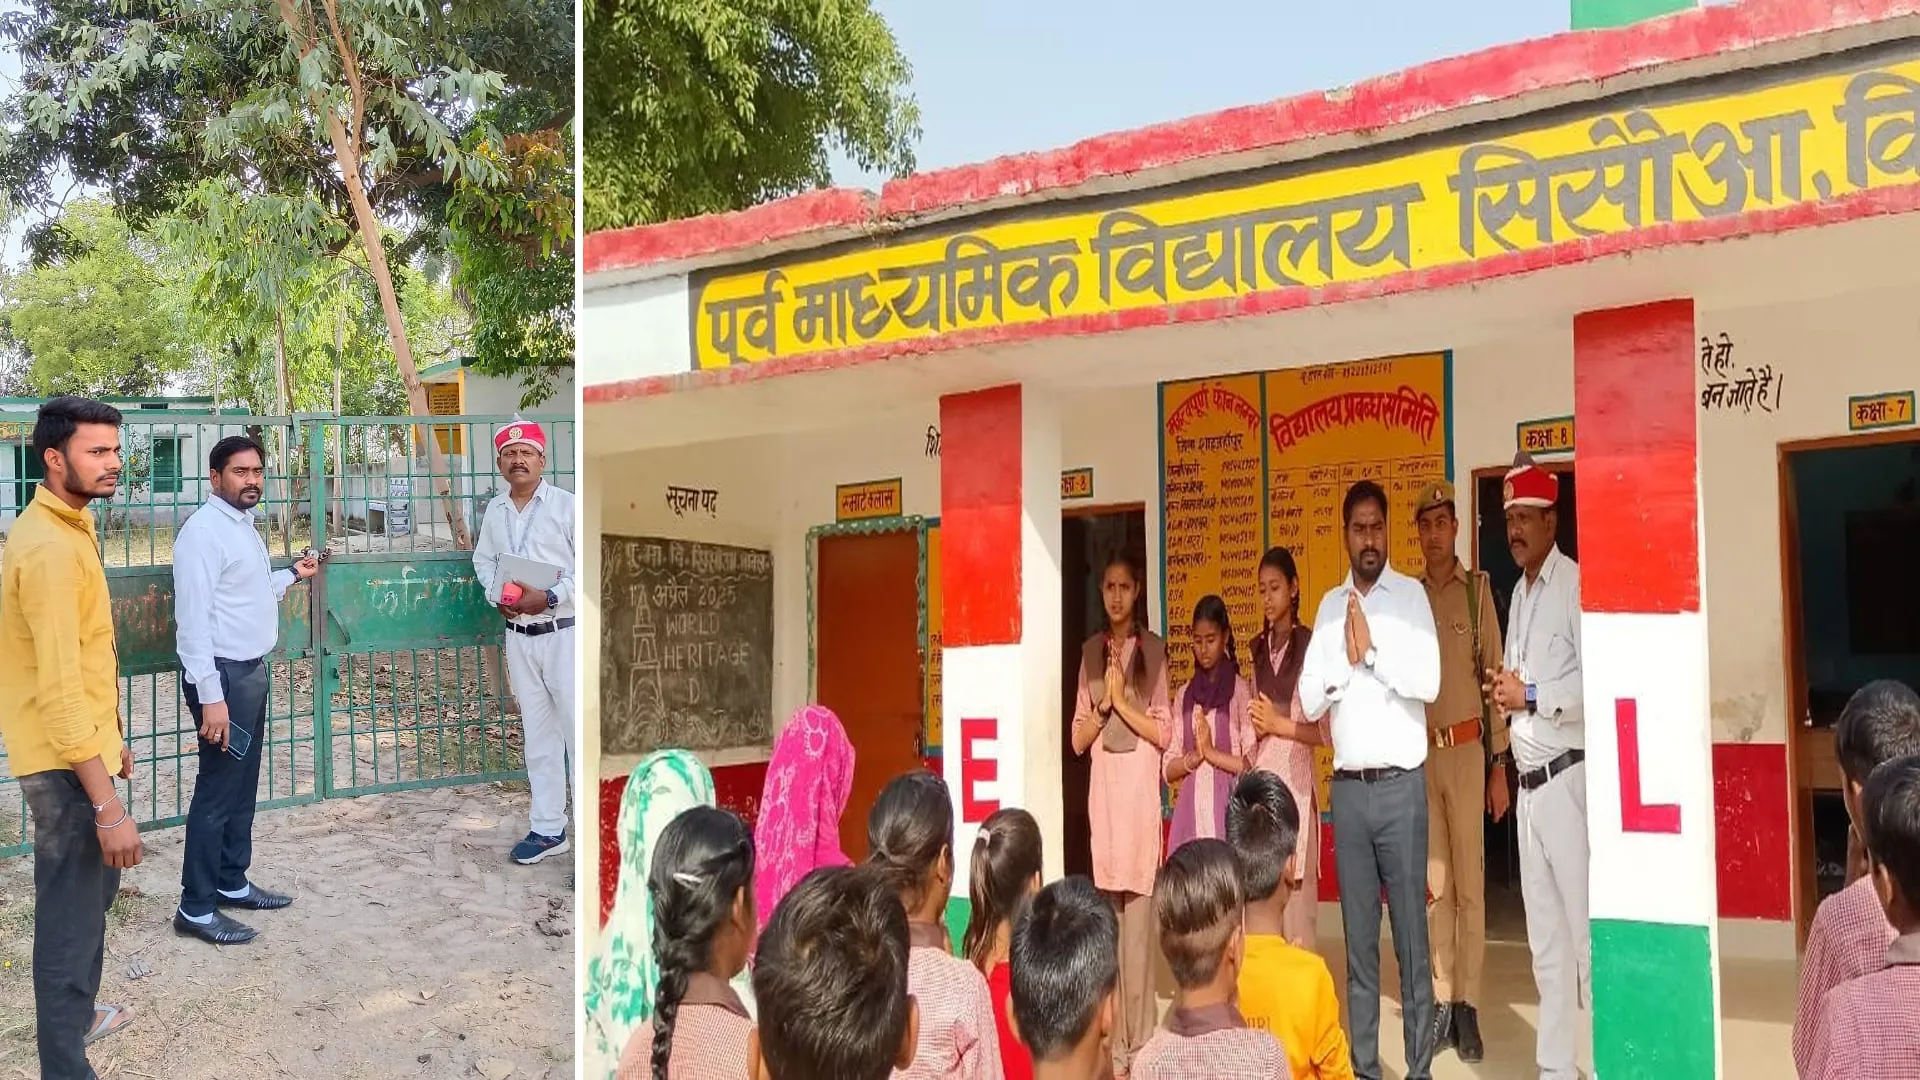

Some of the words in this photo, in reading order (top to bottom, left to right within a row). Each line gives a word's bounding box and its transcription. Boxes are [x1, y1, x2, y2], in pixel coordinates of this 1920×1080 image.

[793, 233, 1081, 346] माध्यमिक
[1088, 182, 1425, 305] विद्यालय
[664, 641, 750, 671] HERITAGE
[666, 611, 720, 637] WORLD
[961, 718, 1000, 823] E
[1615, 698, 1682, 834] L
